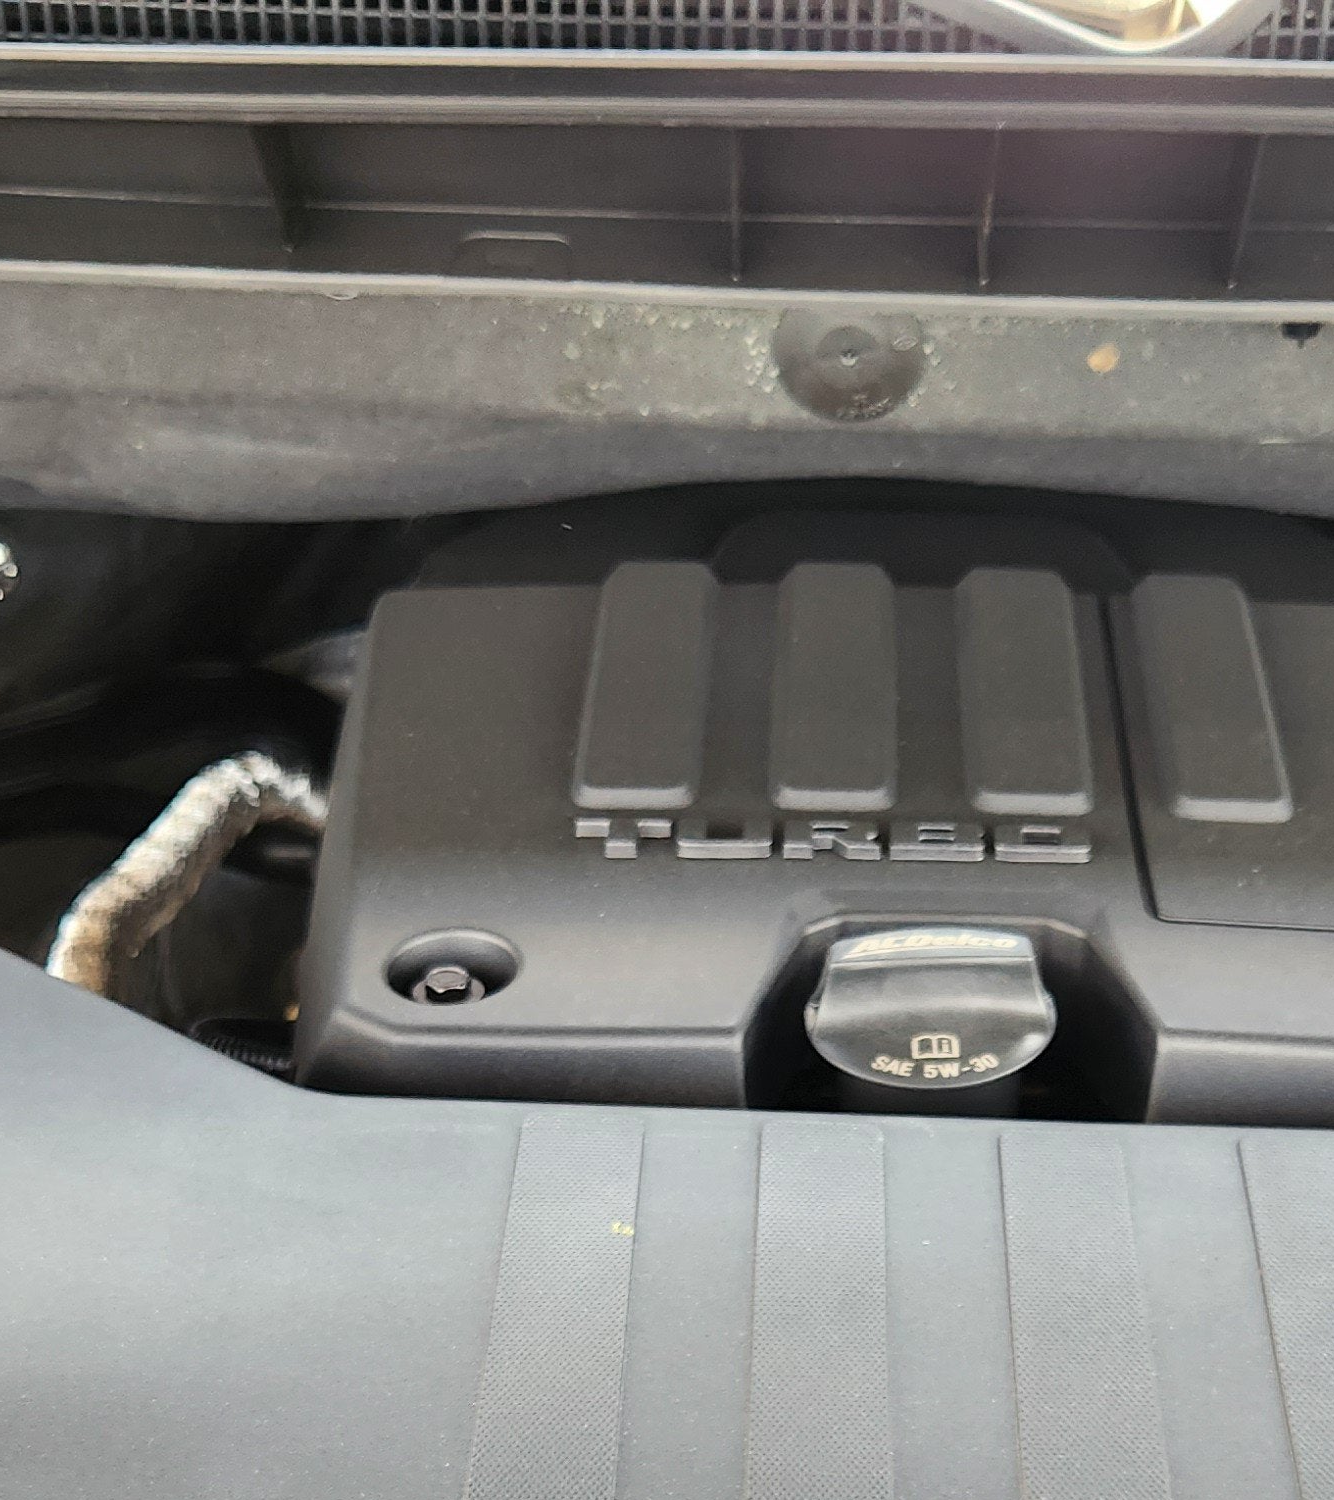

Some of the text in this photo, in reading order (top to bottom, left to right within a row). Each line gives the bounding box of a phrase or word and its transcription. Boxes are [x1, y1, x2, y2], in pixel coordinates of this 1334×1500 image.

[575, 813, 1091, 863] TURBO
[870, 1053, 1000, 1079] SAE 5W-30
